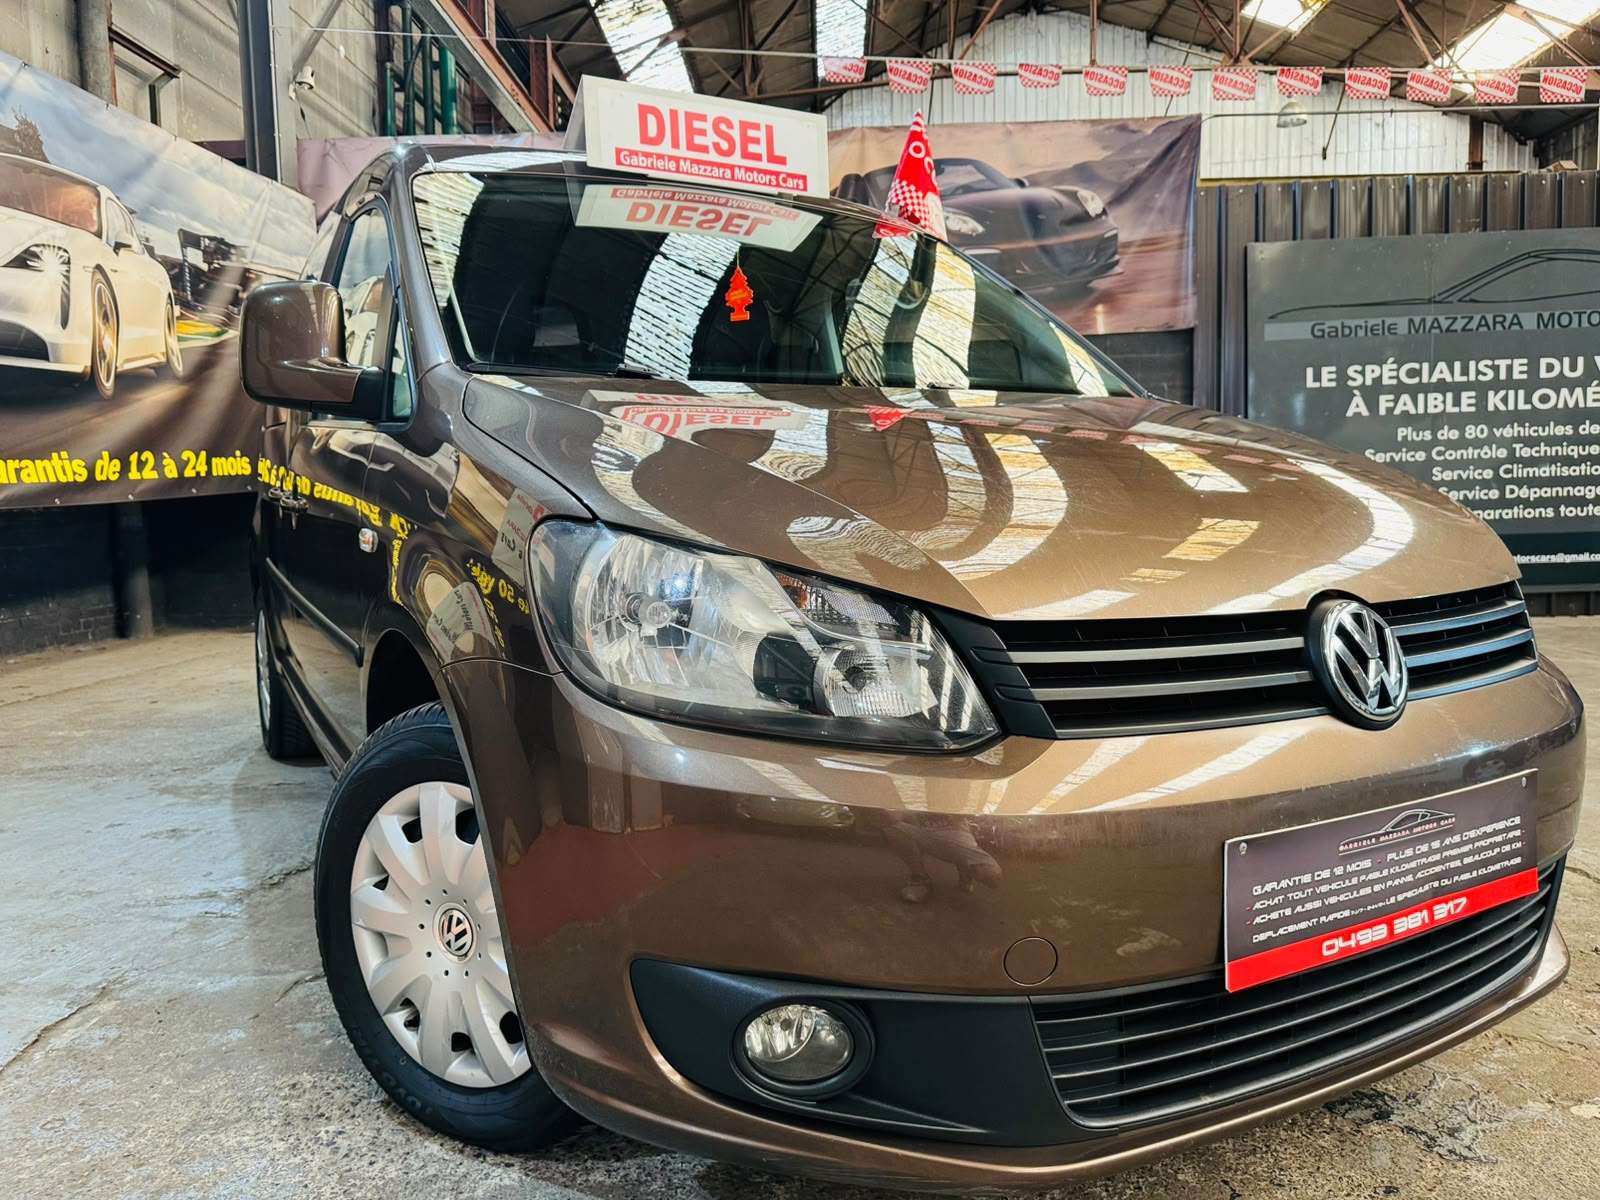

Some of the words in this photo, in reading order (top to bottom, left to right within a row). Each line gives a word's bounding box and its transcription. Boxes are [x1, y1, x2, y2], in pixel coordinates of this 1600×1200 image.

[637, 103, 788, 167] DIESEL
[619, 150, 676, 172] Gabriele
[679, 159, 732, 179] Mazzara
[734, 167, 777, 187] Motors
[779, 173, 805, 190] Cars
[1310, 320, 1398, 340] Gabriele
[1407, 313, 1524, 335] MAZZARA
[1305, 365, 1337, 389] LE
[1346, 357, 1528, 388] SPÉCIALISTE
[1539, 356, 1585, 379] DU
[1345, 389, 1370, 417] À
[1378, 391, 1476, 417] FAIBLE
[1487, 379, 1600, 412] KILOMÉ
[1397, 426, 1432, 442] Plus
[1437, 425, 1460, 441] de
[1464, 424, 1488, 439] 80
[1493, 421, 1574, 438] véhicules
[95, 451, 121, 481] de
[128, 450, 159, 480] 12
[162, 452, 178, 479] à
[181, 450, 208, 477] 24
[211, 450, 251, 476] mois
[1364, 448, 1426, 464] Service
[1431, 443, 1508, 462] Contrôle
[1512, 441, 1600, 460] Technique
[1432, 465, 1494, 482] Service
[1252, 873, 1312, 896] GARANTIE
[1314, 869, 1331, 881] DE
[1346, 858, 1372, 873] MOIS
[1386, 848, 1414, 862] PLUS
[1415, 843, 1429, 855] DE
[1442, 834, 1461, 846] ANS
[1252, 894, 1285, 911] ACHAT
[1287, 886, 1313, 901] TOUT
[1314, 876, 1358, 894] VEHICULE
[1359, 868, 1388, 883] FAIBLE
[1442, 843, 1473, 858] PREMIER
[1294, 899, 1322, 914] AUSSI
[1323, 886, 1372, 905] VEHICULES
[1373, 882, 1386, 893] EN
[1463, 847, 1501, 865] BEAUCOUP
[1501, 843, 1511, 853] DE
[1319, 909, 1351, 924] RAPIDE
[1386, 895, 1396, 905] LE
[1440, 876, 1451, 887] DU
[1321, 923, 1388, 957] 0493
[1393, 909, 1429, 934] 381
[1433, 897, 1468, 923] 317
